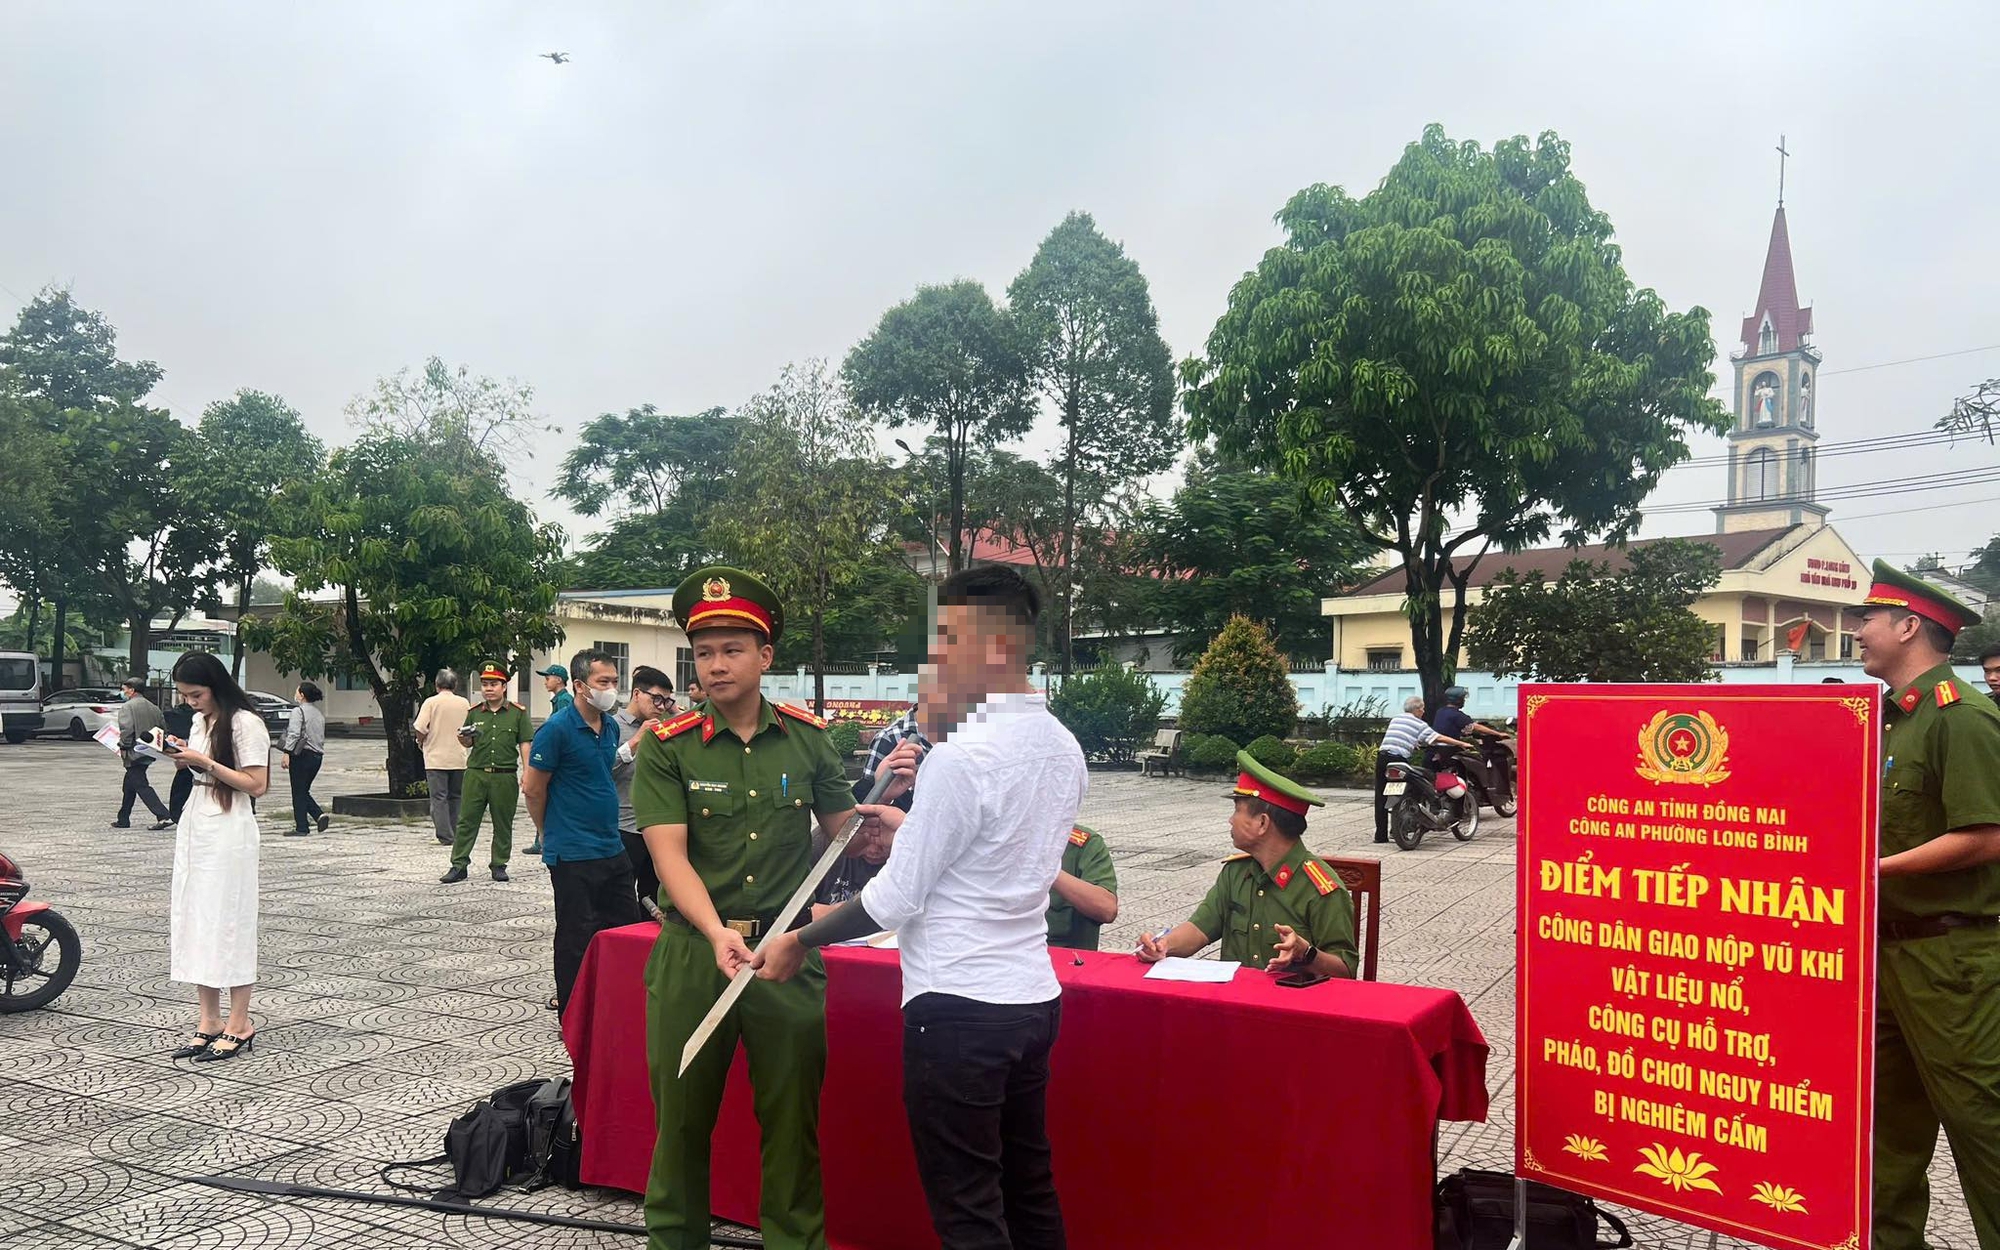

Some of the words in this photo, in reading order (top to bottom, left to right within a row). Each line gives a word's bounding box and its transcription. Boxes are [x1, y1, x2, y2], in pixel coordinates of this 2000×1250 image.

[1569, 817, 1610, 837] CÔNG
[1615, 821, 1635, 839] AN
[1641, 823, 1707, 844] PHƯỜNG
[1713, 830, 1758, 849] LONG
[1764, 830, 1808, 852] BÌNH
[1587, 794, 1628, 814] CÔNG
[1634, 800, 1654, 816] AN
[1660, 798, 1698, 819] TỈNH
[1702, 800, 1751, 822] ĐỒNG
[1756, 807, 1786, 825] NAI
[1539, 850, 1622, 899] ĐIỂM
[1632, 862, 1709, 909] TIẾP
[1720, 876, 1844, 928] NHẬN
[1538, 912, 1592, 946] CÔNG
[1599, 920, 1642, 952] DÂN
[1648, 929, 1699, 960] GIAO
[1706, 934, 1754, 972] NỘP
[1762, 942, 1793, 974] VŨ
[1801, 948, 1844, 982] KHÍ
[1611, 964, 1650, 999] VẬT
[1656, 973, 1702, 1008] LIỆU
[1710, 976, 1750, 1016] NỔ,
[1588, 1003, 1645, 1038] CÔNG
[1652, 1016, 1681, 1050] CỤ
[1688, 1016, 1717, 1051] HỖ
[1724, 1028, 1777, 1067] TRỢ,
[1544, 1038, 1601, 1076] PHÁO,
[1607, 1046, 1636, 1079] ĐỒ
[1642, 1058, 1692, 1091] CHƠI
[1699, 1069, 1762, 1106] NGUY
[1769, 1079, 1832, 1121] HIỂM
[1594, 1090, 1614, 1122] BỊ
[1621, 1095, 1707, 1139] NGHIÊM
[1714, 1112, 1767, 1153] CẤM
